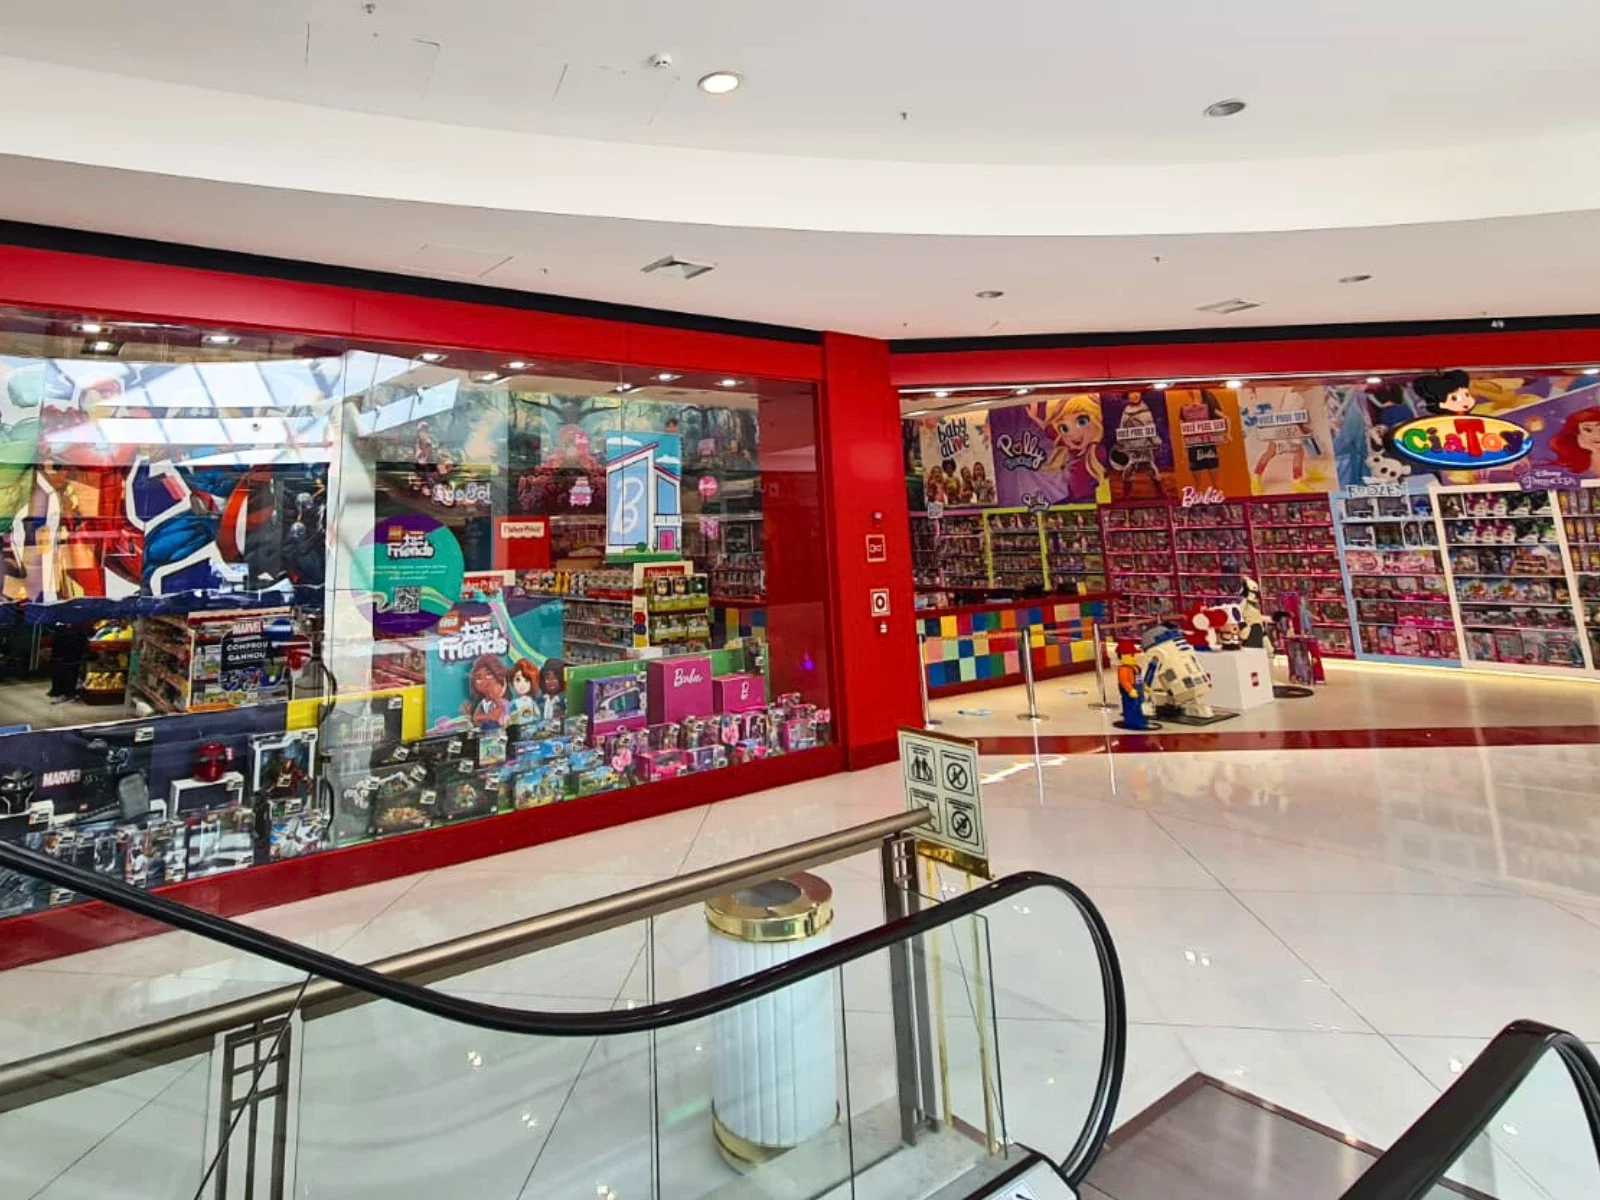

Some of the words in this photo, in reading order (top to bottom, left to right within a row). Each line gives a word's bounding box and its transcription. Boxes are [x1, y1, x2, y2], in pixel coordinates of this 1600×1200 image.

[937, 417, 967, 443] baby
[1403, 419, 1525, 457] CiaToy
[997, 431, 1046, 468] Polly
[1181, 486, 1225, 507] Barbie
[673, 668, 704, 687] Barbie
